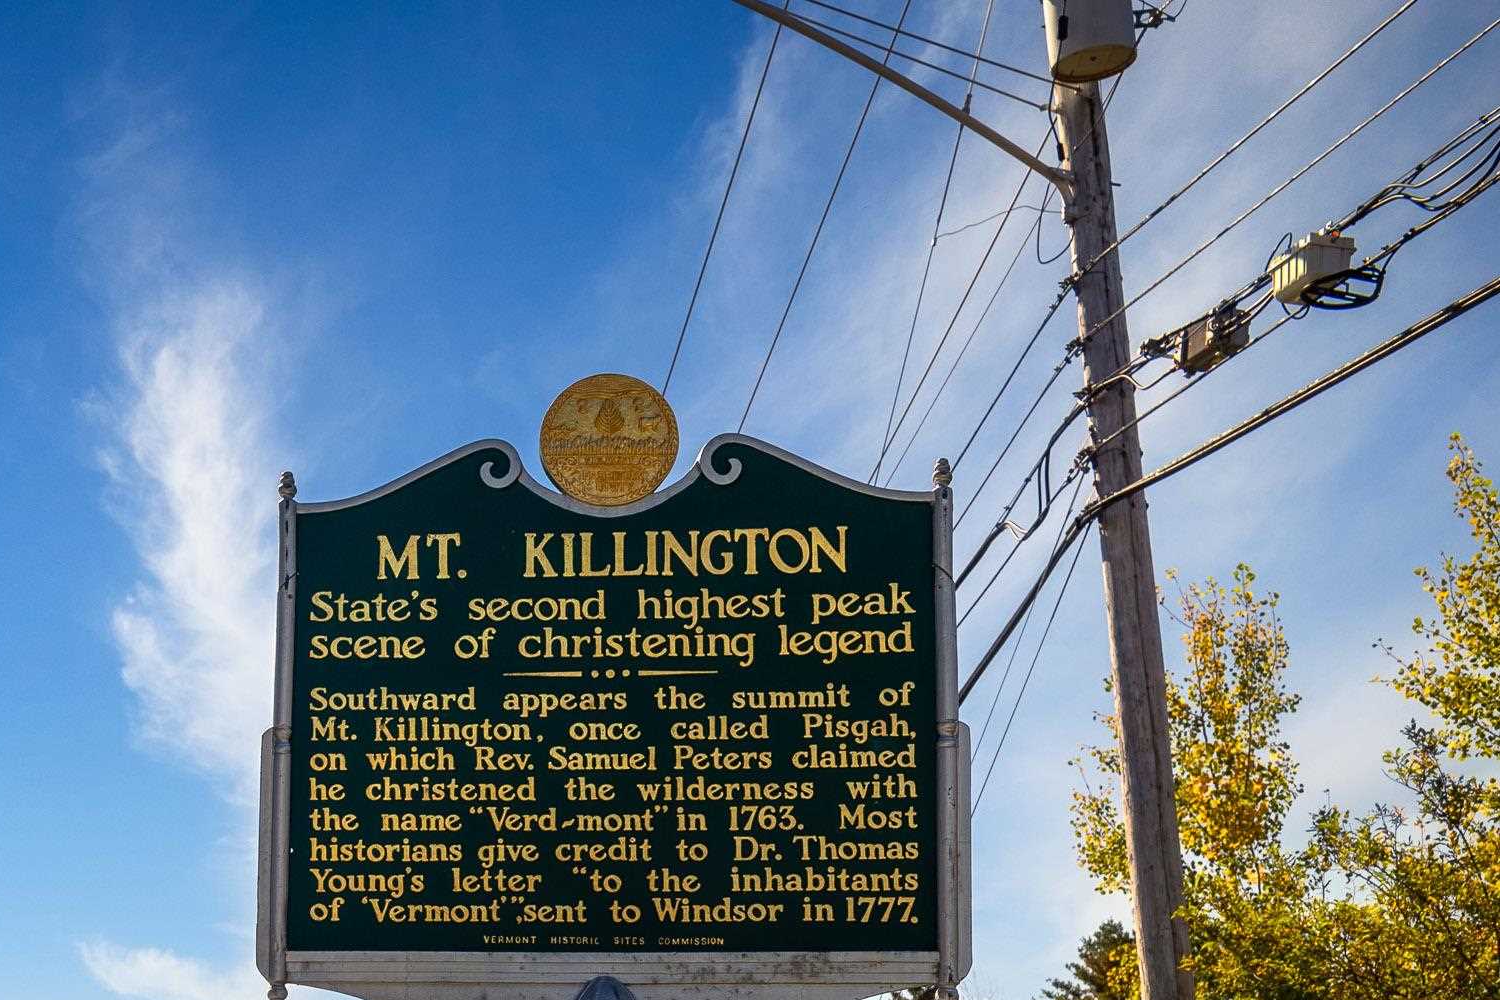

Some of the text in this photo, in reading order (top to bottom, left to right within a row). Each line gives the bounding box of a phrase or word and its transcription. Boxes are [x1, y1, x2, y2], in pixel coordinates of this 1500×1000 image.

[376, 525, 849, 580] MT. KILLINGTON
[309, 582, 917, 630] State's second highest peak
[309, 621, 915, 668] scene of christening legend
[309, 681, 916, 718] Southward appears the summit of
[310, 713, 917, 748] Mt. Killington, once called Pisgah,
[309, 743, 917, 772] on which Rev. Samuel Peters claimed
[308, 773, 918, 802] he christened the wilderness with
[308, 807, 360, 832] the
[380, 812, 463, 832] name
[676, 806, 708, 832] in
[728, 804, 804, 832] 1763.
[838, 803, 918, 830] Most
[309, 835, 919, 869] historians give credit to Dr. Thomas
[309, 866, 425, 899] Young's
[451, 867, 542, 893] letter
[646, 867, 701, 893] the
[730, 865, 919, 892] inhabitants
[309, 896, 345, 922] of
[609, 900, 641, 923] to
[651, 896, 784, 923] Windsor
[802, 896, 835, 922] in
[845, 895, 919, 924] 1777.
[483, 935, 725, 946] VERMONT HISTORIC SITES COMMISSION
